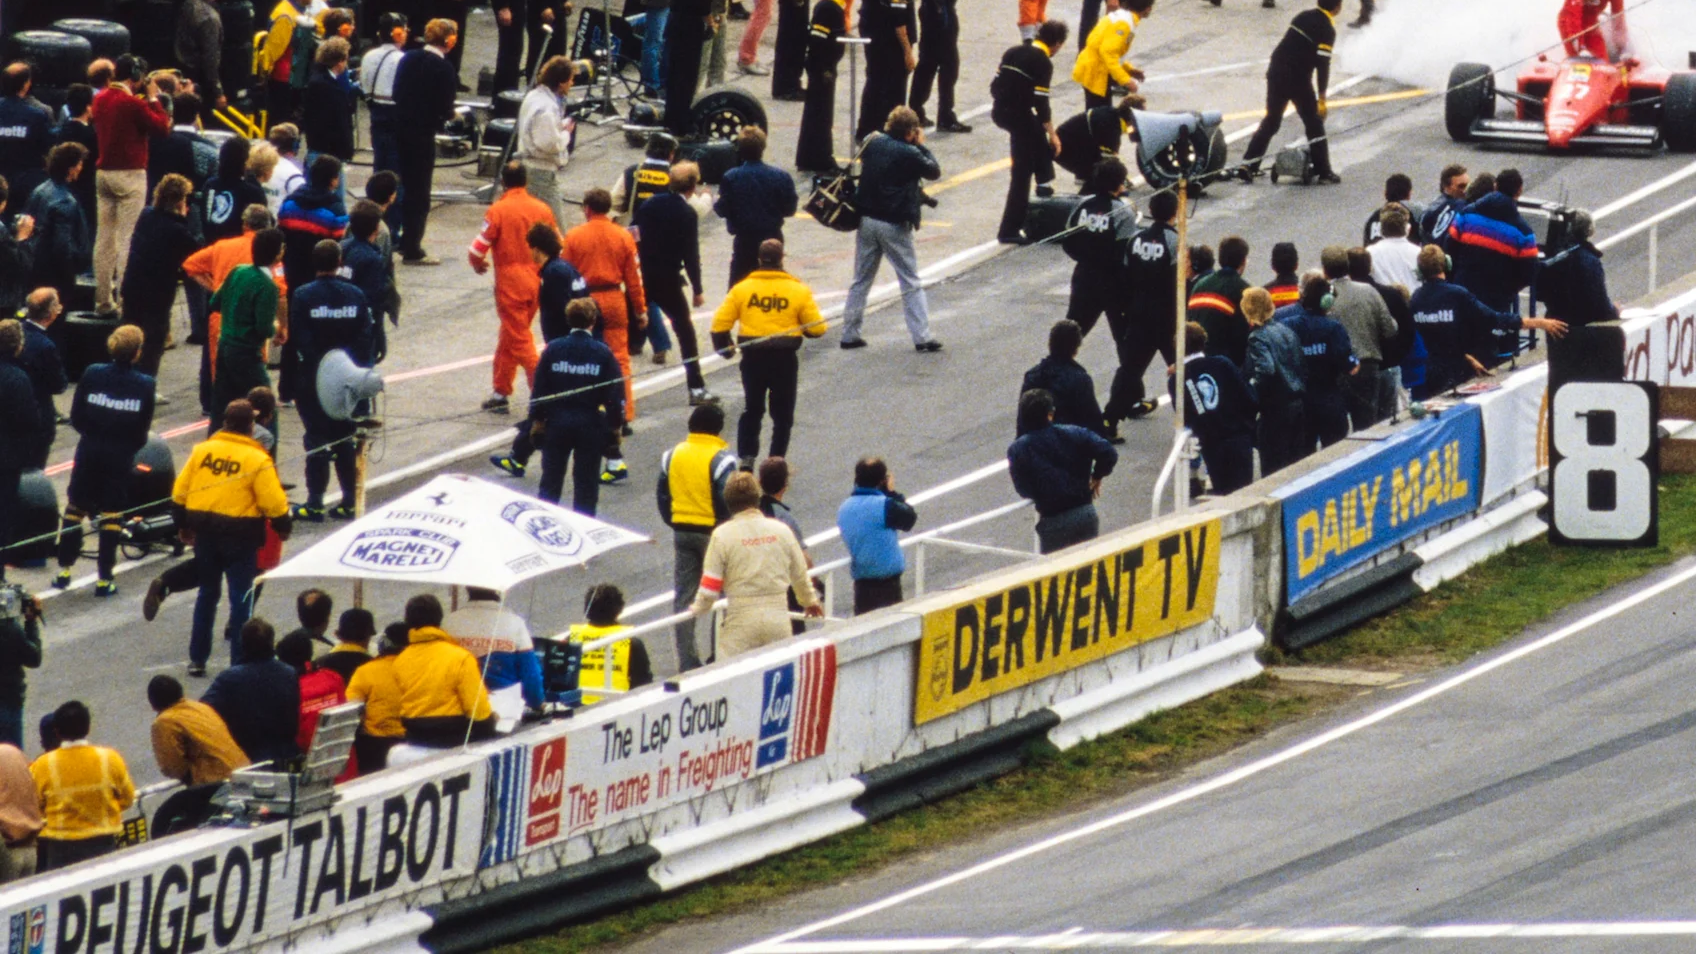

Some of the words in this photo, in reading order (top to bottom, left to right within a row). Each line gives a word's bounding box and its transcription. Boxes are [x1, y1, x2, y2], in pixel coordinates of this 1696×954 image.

[1078, 208, 1110, 233] Agip
[1132, 237, 1164, 261] Agip
[310, 305, 358, 319] olivetti
[746, 292, 789, 313] Agip
[551, 360, 600, 377] olivetti
[87, 392, 141, 412] olivetti
[199, 452, 241, 477] Agip
[1552, 381, 1651, 539] 8
[385, 510, 467, 529] Ferrari
[1295, 476, 1382, 579] DAILY
[1389, 440, 1470, 528] MAIL
[366, 527, 412, 538] SPARK
[741, 533, 778, 547] DOCTOR
[952, 550, 1146, 695] DERWENT
[1160, 526, 1208, 621] TV
[762, 670, 791, 722] Lep
[602, 723, 634, 765] The
[640, 713, 671, 755] Lep
[679, 696, 729, 739] Group
[533, 761, 564, 801] Lep
[568, 786, 599, 822] The
[605, 772, 651, 814] name
[657, 762, 671, 799] in
[677, 737, 754, 793] Freighting
[57, 833, 283, 954] PEUGEOT
[293, 772, 471, 919] TALBOT
